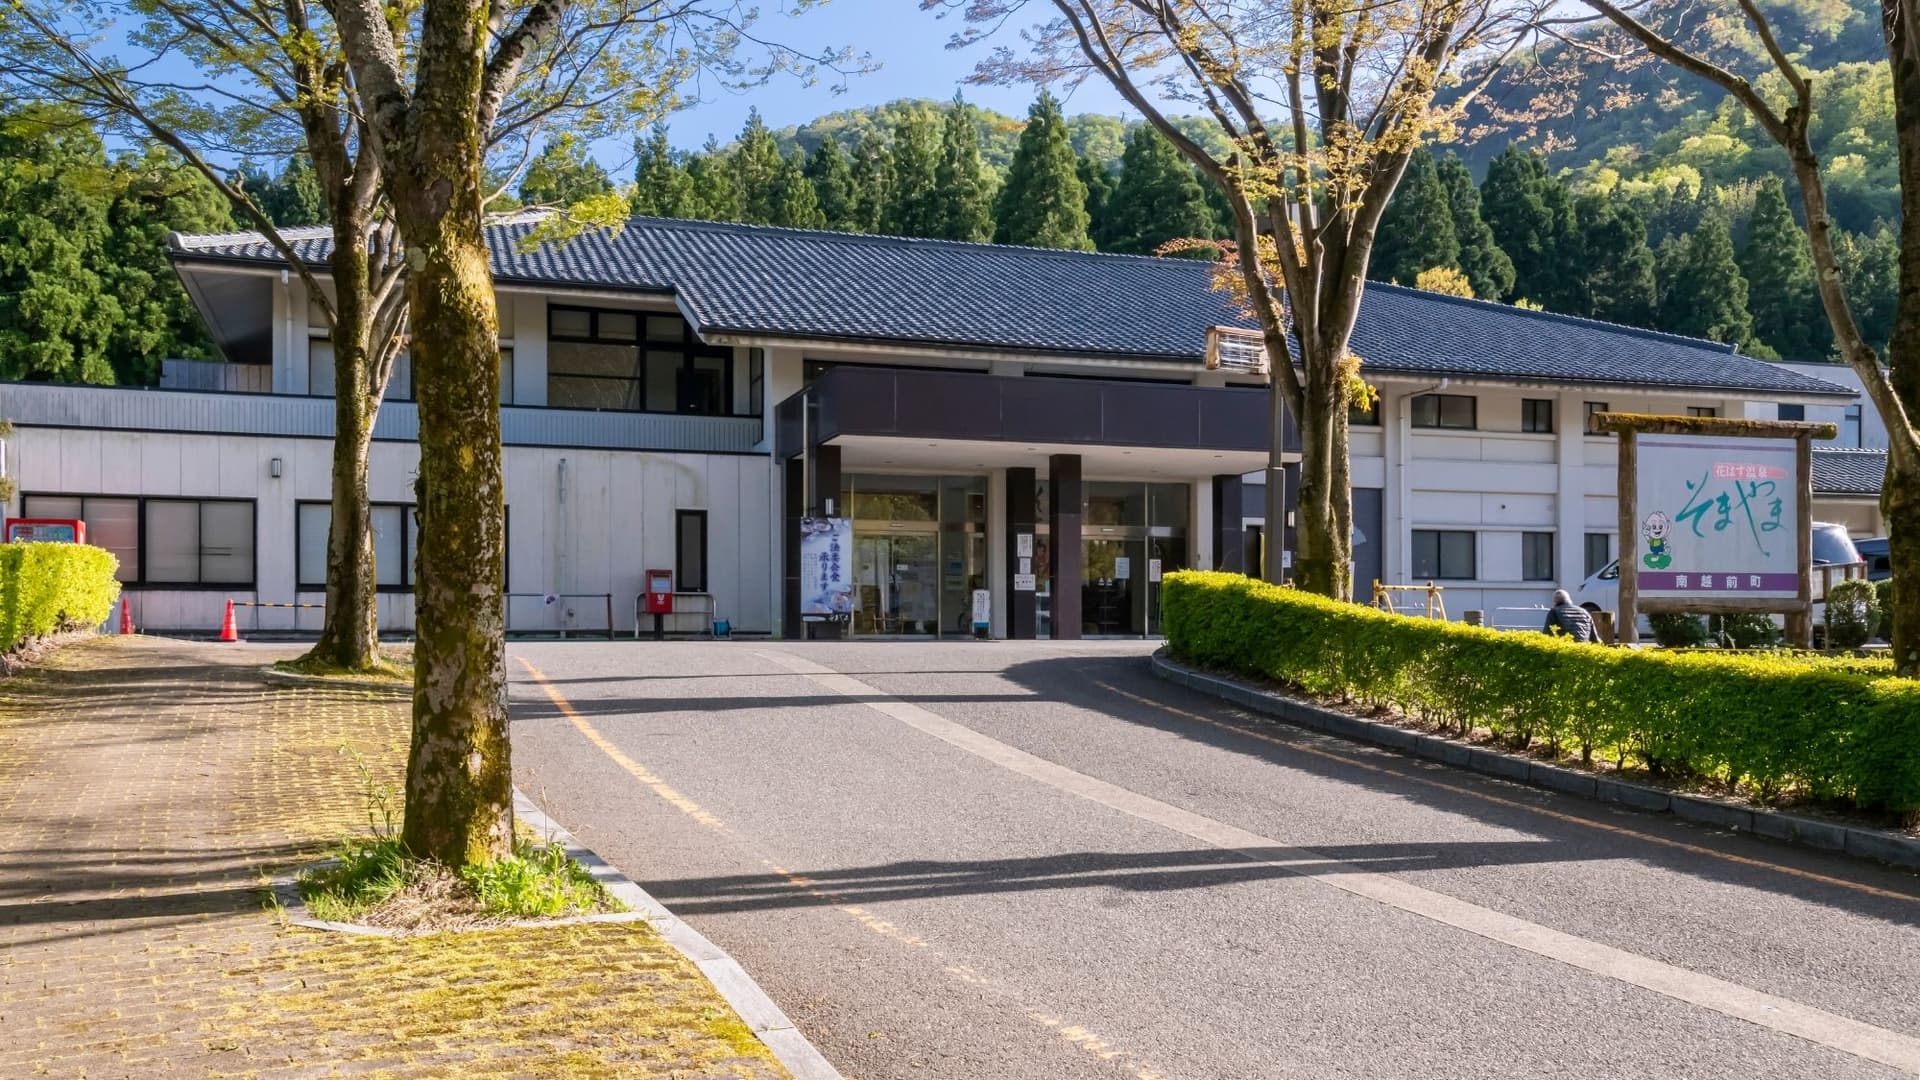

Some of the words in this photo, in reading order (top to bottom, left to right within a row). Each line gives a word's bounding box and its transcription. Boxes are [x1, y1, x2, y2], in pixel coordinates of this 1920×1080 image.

[1716, 465, 1768, 478] 花はす温泉
[1675, 472, 1786, 557] そまやま
[819, 552, 830, 591] 承ります
[1676, 575, 1761, 589] 南越前町
